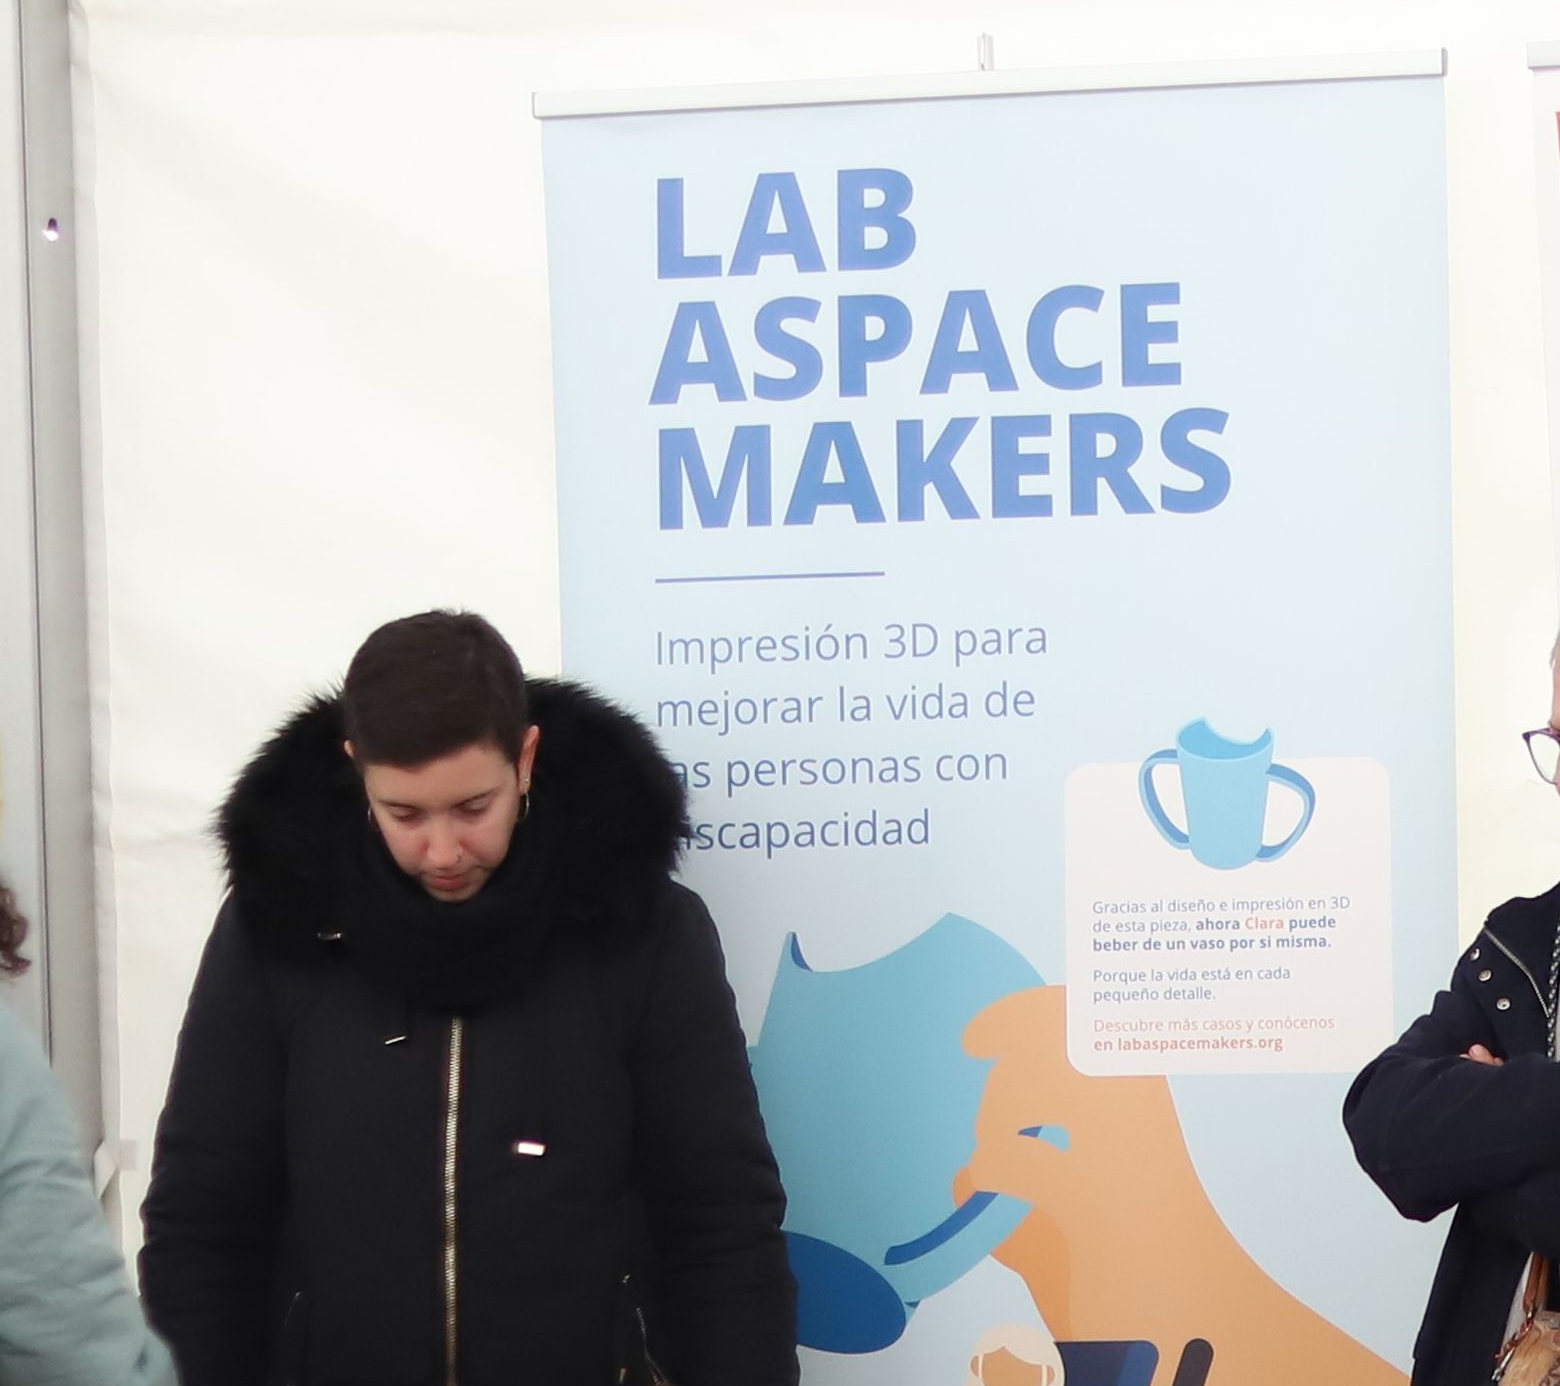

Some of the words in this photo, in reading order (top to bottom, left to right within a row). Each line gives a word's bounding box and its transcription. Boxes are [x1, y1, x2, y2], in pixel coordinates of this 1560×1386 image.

[656, 166, 916, 279] LAB
[648, 282, 1182, 405] ASPACE
[657, 407, 1232, 530] MAKERS
[657, 624, 868, 674] Impresión
[884, 623, 938, 659] 3D
[954, 625, 1048, 667] para
[657, 690, 824, 736] mejorar
[839, 685, 872, 722] la
[886, 683, 969, 720] vida
[984, 680, 1036, 718] de
[670, 760, 711, 789] as
[727, 754, 921, 798] personas
[935, 752, 1008, 782] con
[681, 808, 930, 859] scapacidad
[1093, 900, 1146, 914] Gracias
[1151, 899, 1163, 913] al
[1167, 898, 1215, 913] diseño
[1219, 901, 1228, 911] e
[1232, 897, 1304, 915] impresión
[1308, 900, 1326, 910] en
[1330, 896, 1351, 910] 3D
[1093, 919, 1111, 932] de
[1115, 920, 1145, 932] esta
[1150, 917, 1192, 936] pieza,
[1196, 917, 1240, 931] ahora
[1245, 916, 1284, 930] Clara
[1289, 916, 1336, 934] puede
[1093, 938, 1138, 952] beber
[1143, 937, 1161, 951] de
[1166, 939, 1186, 950] un
[1190, 938, 1225, 949] vaso
[1229, 936, 1255, 952] por
[1259, 935, 1272, 948] si
[1276, 935, 1332, 948] misma.
[1093, 969, 1146, 986] Porque
[1151, 969, 1163, 981] la
[1167, 968, 1197, 981] vida
[1201, 967, 1231, 981] está
[1235, 970, 1253, 980] en
[1257, 966, 1291, 980] cada
[1093, 988, 1159, 1004] pequeño
[1163, 987, 1216, 1001] detalle.
[1094, 1018, 1163, 1033] Descubre
[1168, 1018, 1198, 1031] más
[1202, 1019, 1243, 1030] casos
[1245, 1021, 1255, 1034] y
[1258, 1016, 1335, 1030] conócenos
[1094, 1040, 1113, 1051] en
[1118, 1037, 1284, 1053] labaspacemakers.org
